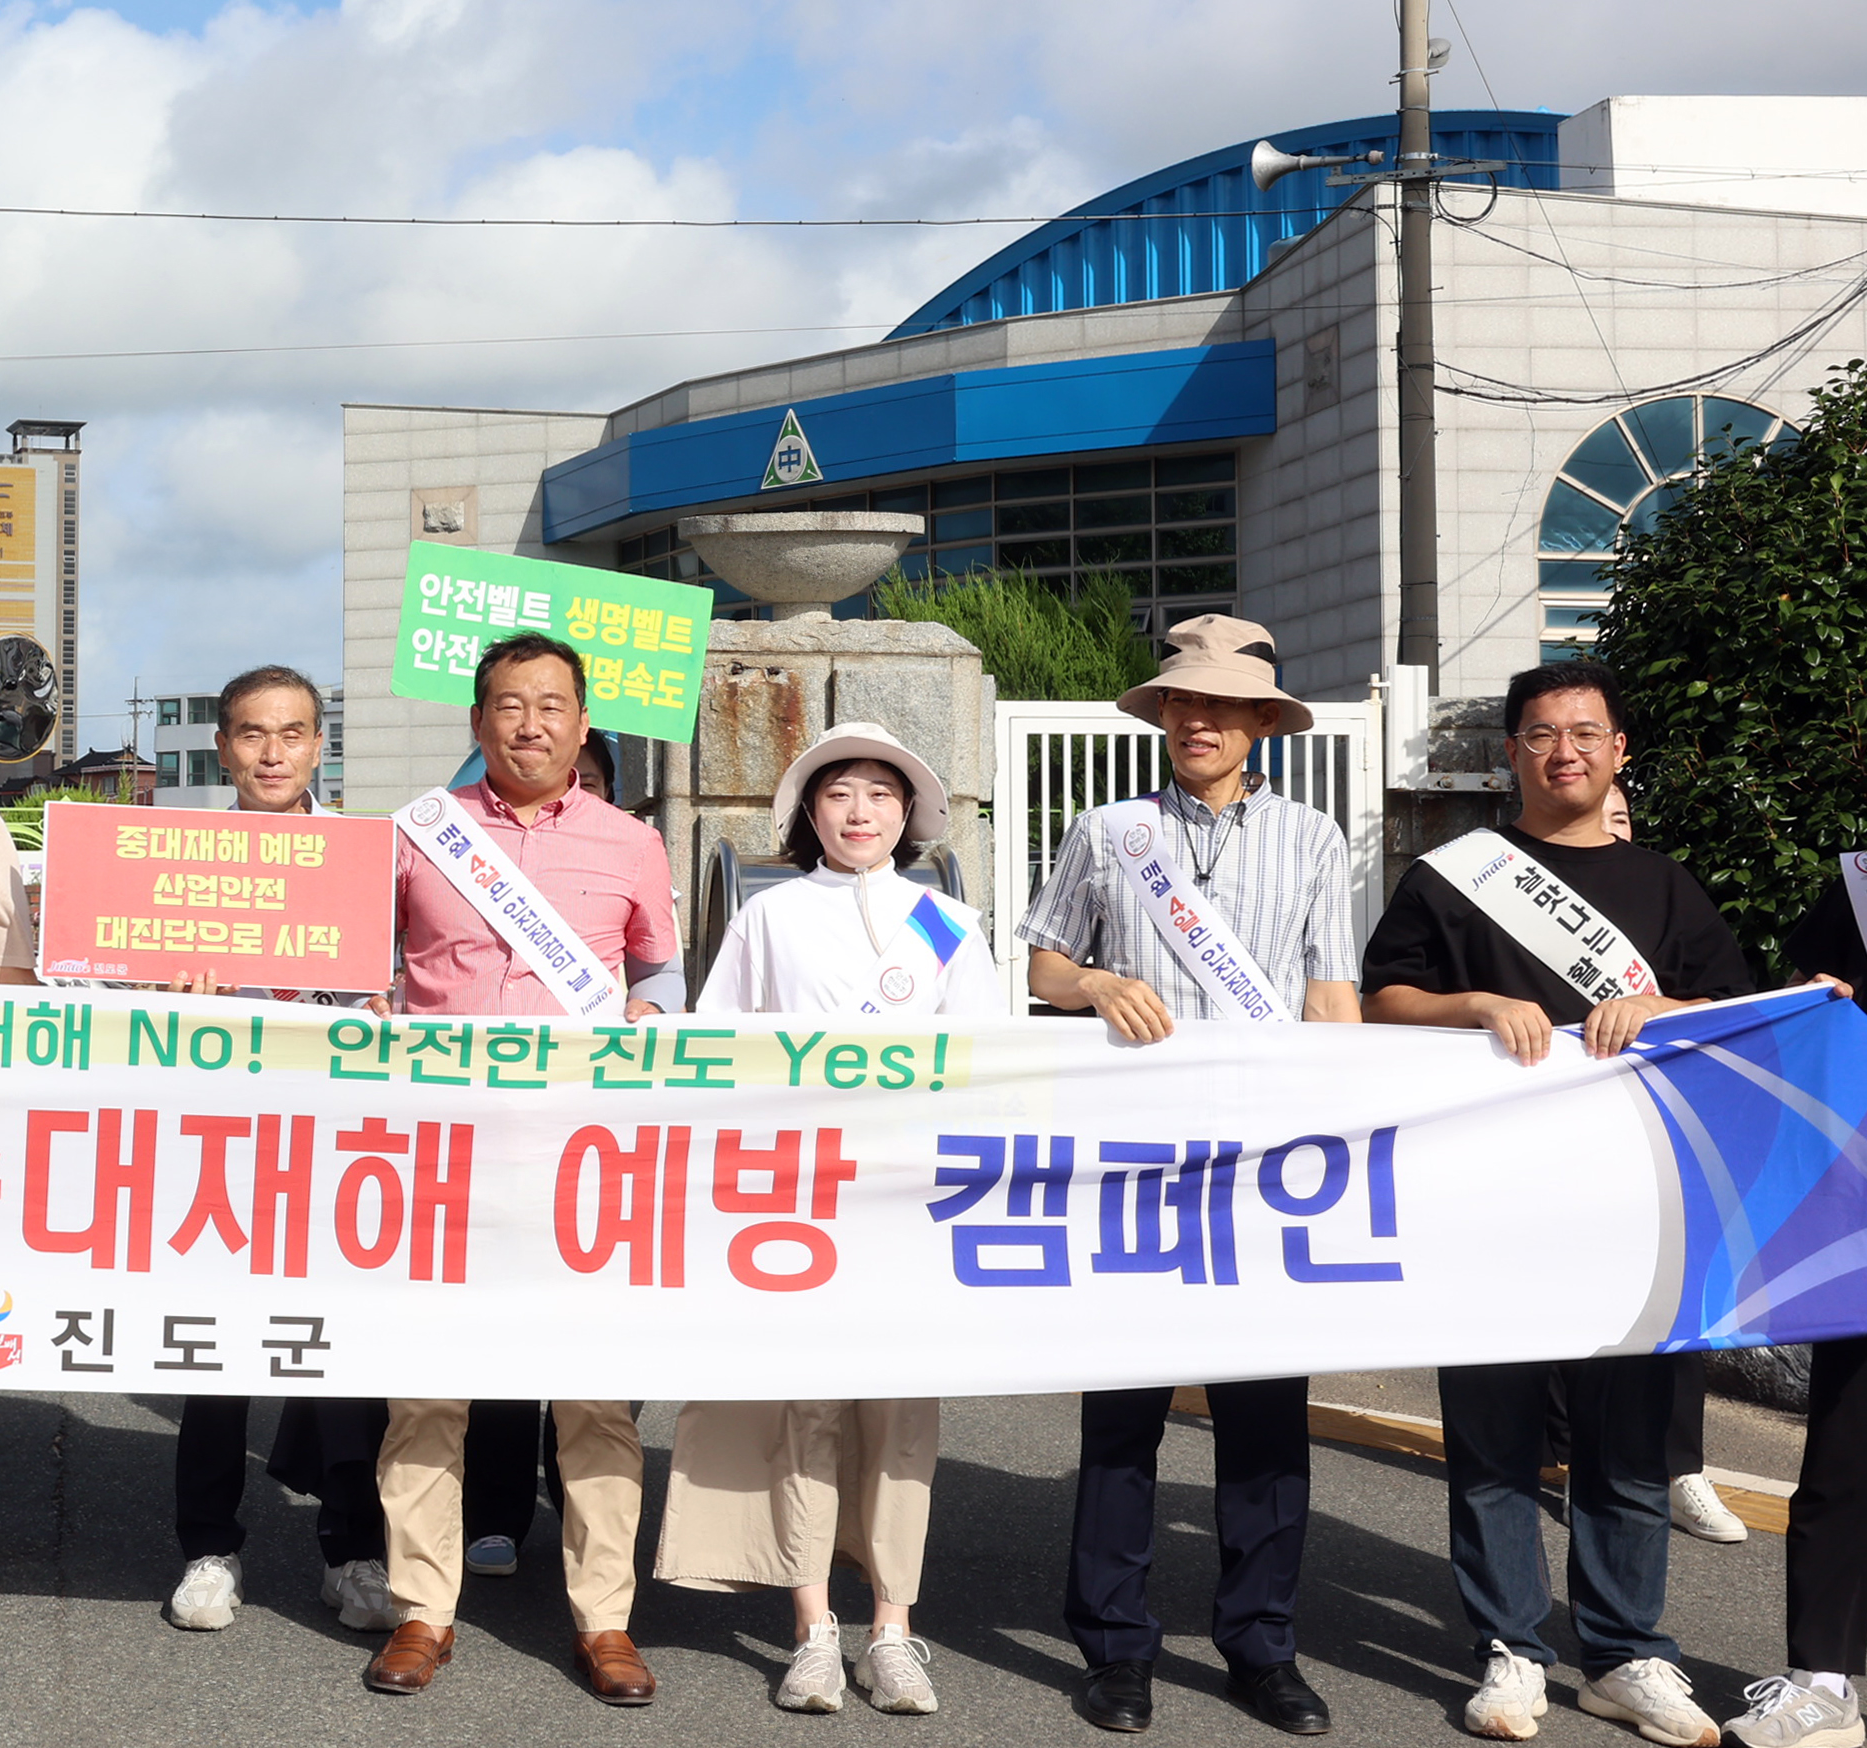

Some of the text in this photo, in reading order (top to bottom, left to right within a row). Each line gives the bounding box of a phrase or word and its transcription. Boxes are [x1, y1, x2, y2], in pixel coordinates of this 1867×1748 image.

[778, 445, 801, 473] 中
[419, 572, 693, 654] 안전벨트 생명벨트
[583, 652, 686, 710] 명속도
[116, 825, 327, 868] 중대재해 예방
[436, 823, 473, 859] 매월
[152, 872, 287, 911] 산업안전
[1140, 859, 1173, 898] 매월
[1472, 858, 1508, 892] Jindo
[1514, 865, 1617, 957] 살맛나는
[95, 915, 342, 960] 대진단으로 시작
[127, 1008, 266, 1075] No!
[326, 1016, 561, 1089] 안전한
[588, 1025, 738, 1090] 진도
[773, 1030, 950, 1093] Yes!
[553, 1123, 859, 1293] 예방
[925, 1124, 1405, 1288] 캠페인
[50, 1307, 332, 1379] 진도군
